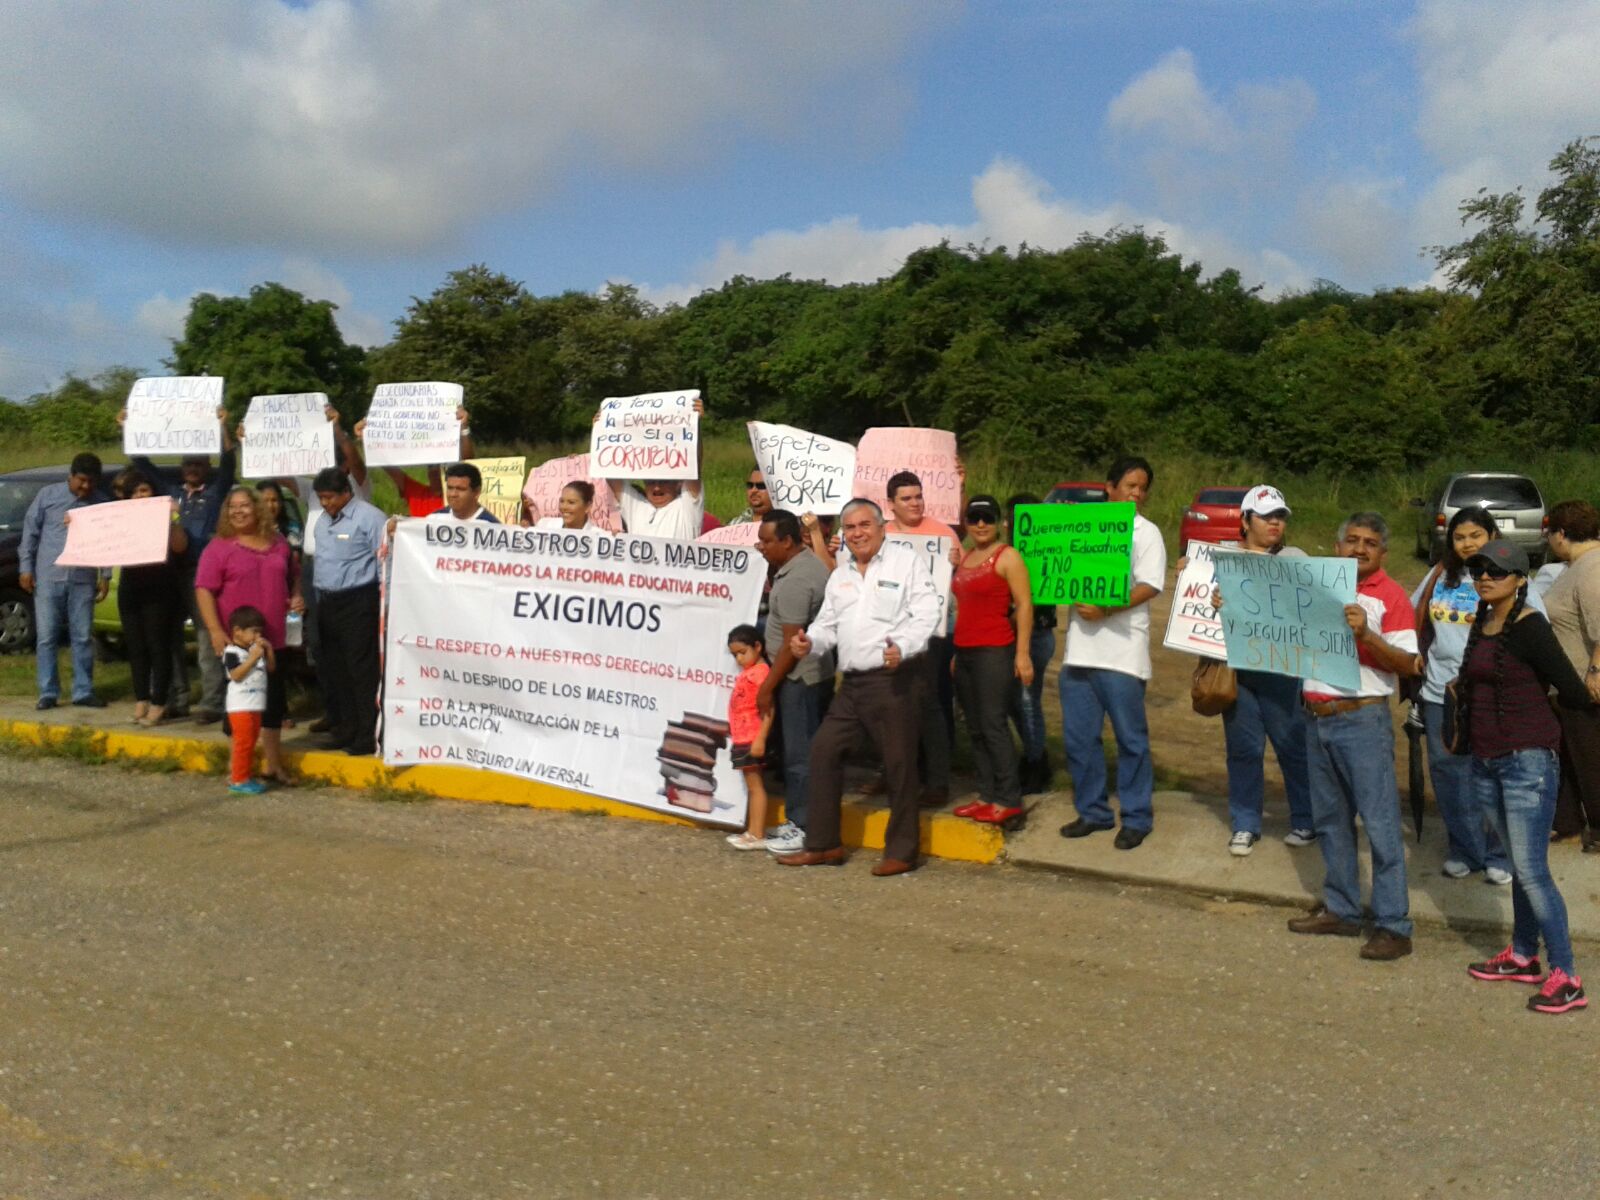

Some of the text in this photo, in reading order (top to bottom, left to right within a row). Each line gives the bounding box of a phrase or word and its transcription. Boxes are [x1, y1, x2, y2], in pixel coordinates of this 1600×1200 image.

[263, 414, 302, 430] FAMILIA
[605, 413, 616, 428] la
[134, 429, 217, 449] VIOLATORIA
[311, 431, 320, 448] A
[596, 433, 632, 451] pero
[665, 432, 674, 441] a
[682, 427, 693, 442] la
[1018, 511, 1129, 537] Queremos una
[426, 524, 749, 573] LOS MAESTROS DE CD. MADERO
[1018, 540, 1063, 558] Reforma
[436, 557, 733, 602] RESPETAMOS LA REFORMA EDUCATIVA PERO,
[1031, 573, 1129, 604] ABORAL!
[1320, 563, 1348, 590] LA
[1182, 582, 1210, 599] NO
[1240, 578, 1313, 622] SEP
[513, 591, 661, 632] EXIGIMOS
[1242, 622, 1310, 648] SEGUIRÉ
[416, 636, 432, 649] EL
[435, 638, 502, 656] RESPETO
[506, 645, 516, 658] A
[520, 647, 602, 667] NUESTROS
[605, 656, 674, 678] DERECHOS
[420, 666, 659, 711] NO AL DESPIDO DE LOS MAESTROS.
[419, 713, 502, 734] EDUCACIÓN.
[420, 698, 620, 739] NO A LA PRIVATIZACIÓN DE LA
[418, 745, 442, 759] NO
[446, 746, 464, 760] AL
[466, 747, 515, 769] SEGURO
